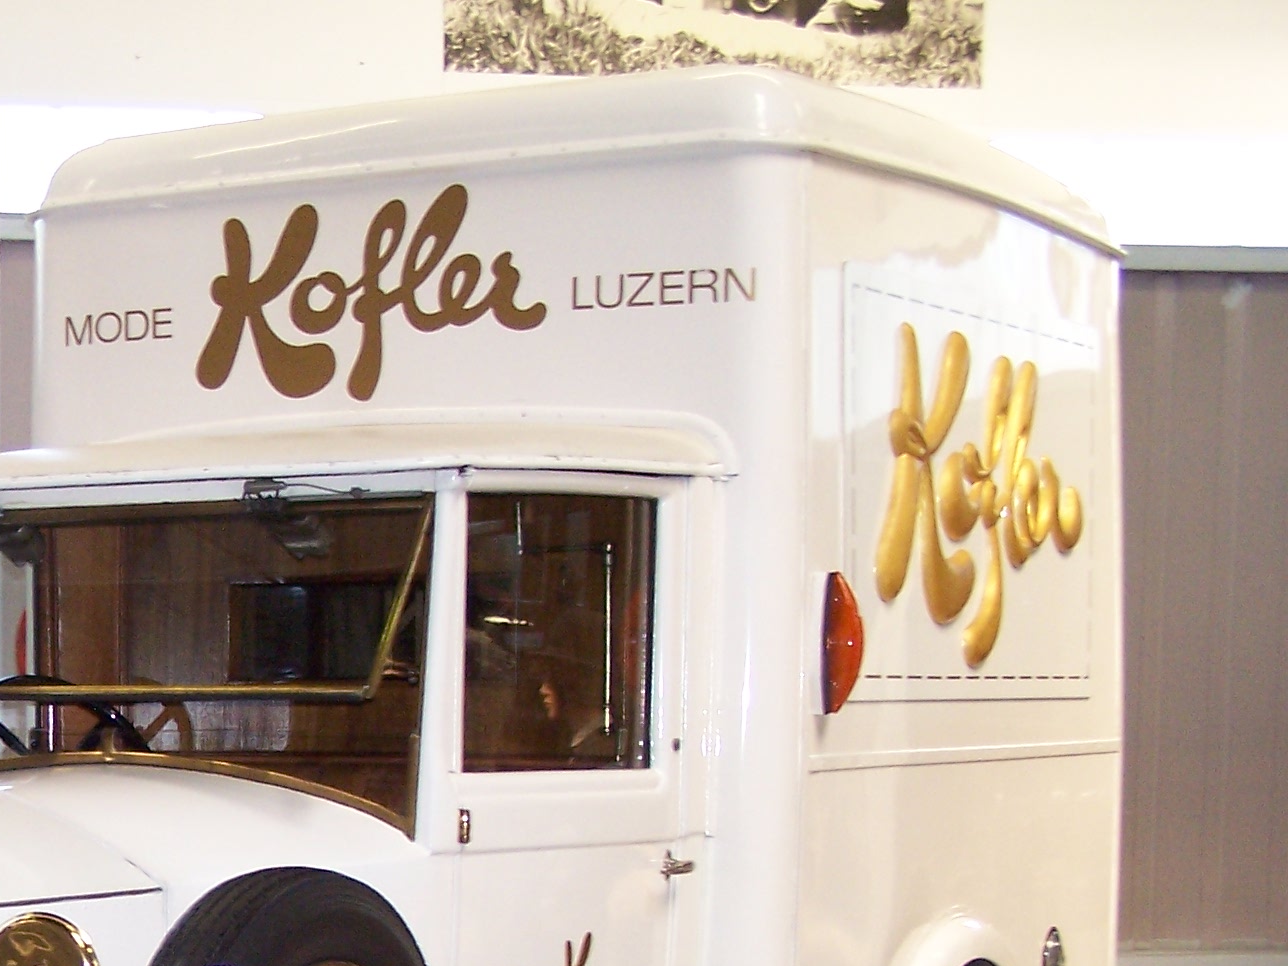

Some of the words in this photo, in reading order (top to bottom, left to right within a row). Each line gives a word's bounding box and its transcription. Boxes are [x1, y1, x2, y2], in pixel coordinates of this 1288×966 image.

[64, 308, 173, 347] MODE
[196, 184, 548, 402] Kofler
[572, 267, 757, 310] LUZERN
[874, 322, 1083, 669] Kofler
